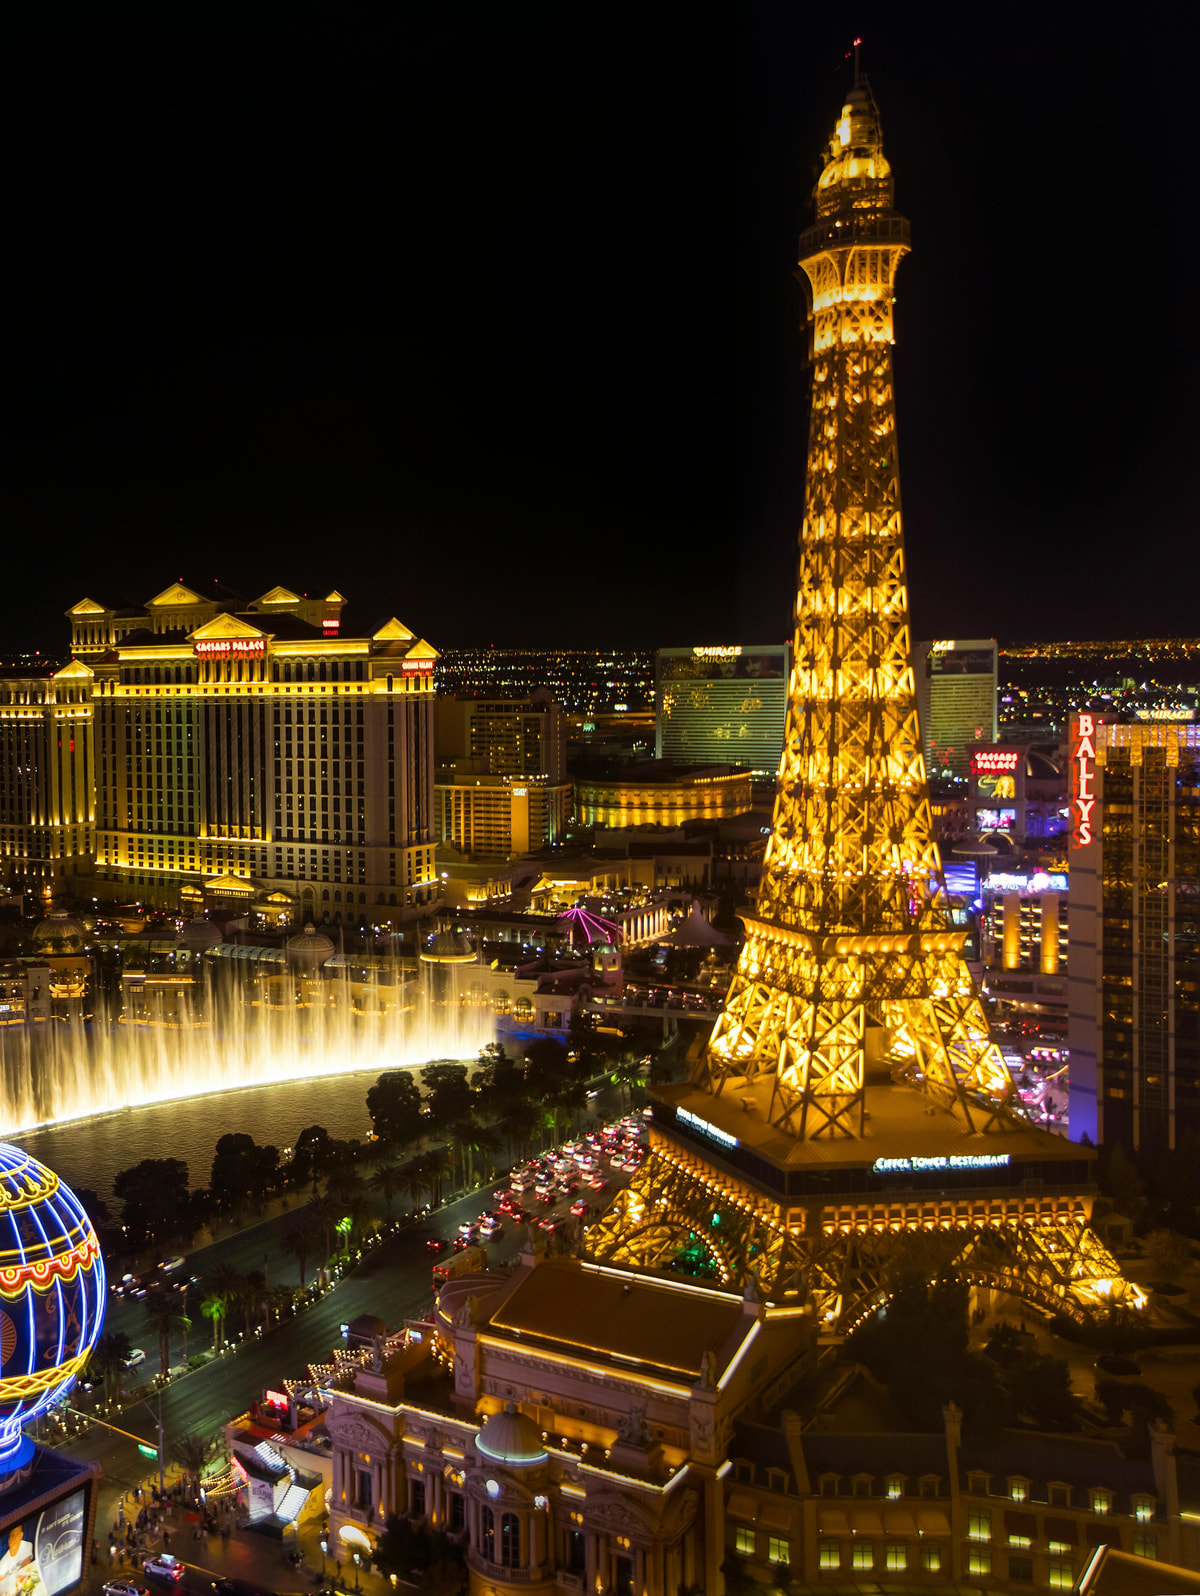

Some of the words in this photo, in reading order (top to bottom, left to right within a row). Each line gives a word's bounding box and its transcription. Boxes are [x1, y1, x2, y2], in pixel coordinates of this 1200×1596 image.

[195, 641, 231, 652] CAESARS
[232, 640, 265, 651] PALACE
[932, 640, 955, 651] AGE
[704, 646, 742, 657] MIRAGE
[1150, 710, 1194, 720] MIRAGE
[974, 752, 1018, 761] CAESARS
[977, 760, 1016, 769] PALACE
[1076, 714, 1096, 845] BALLYS
[911, 1156, 947, 1168] TOWER
[949, 1154, 1011, 1166] RESTAURANT
